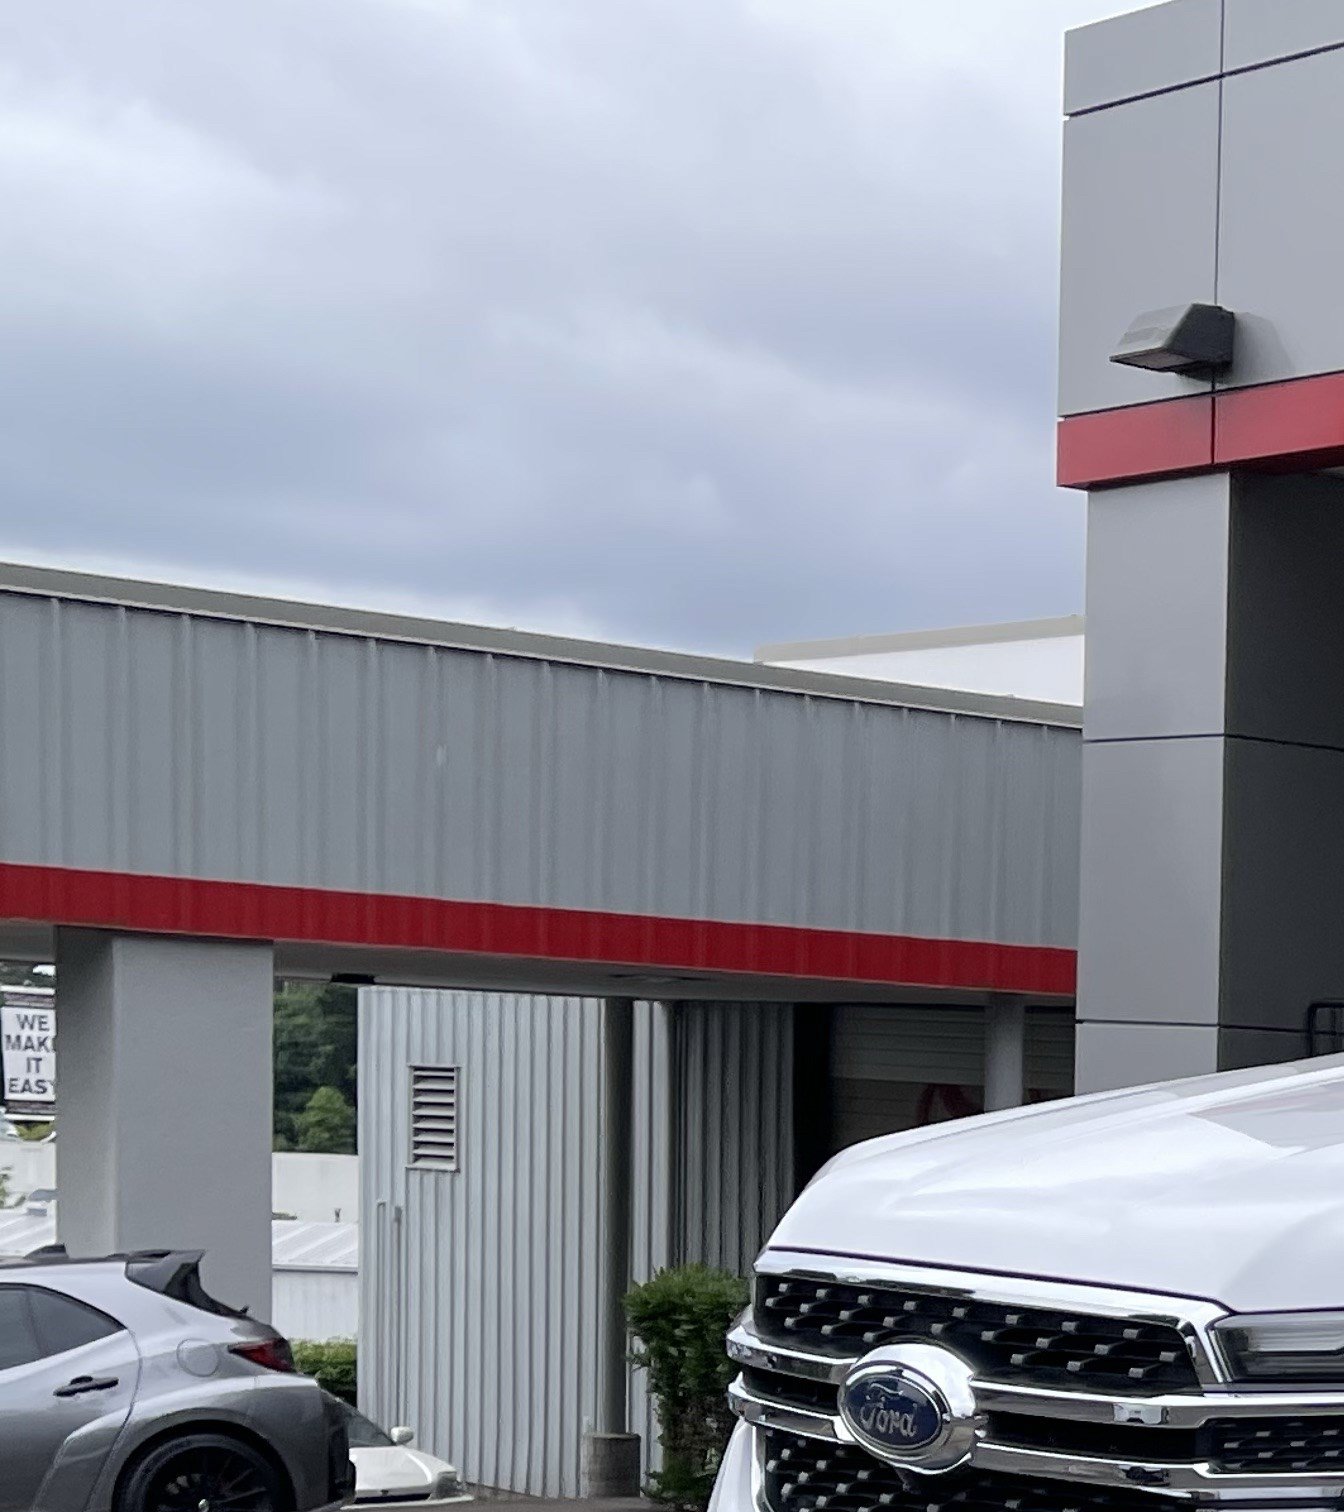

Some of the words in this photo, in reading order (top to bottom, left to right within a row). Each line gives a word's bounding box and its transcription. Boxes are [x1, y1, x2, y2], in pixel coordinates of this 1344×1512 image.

[16, 1013, 50, 1032] WE
[25, 1056, 43, 1074] IT
[859, 1382, 918, 1438] Ford
